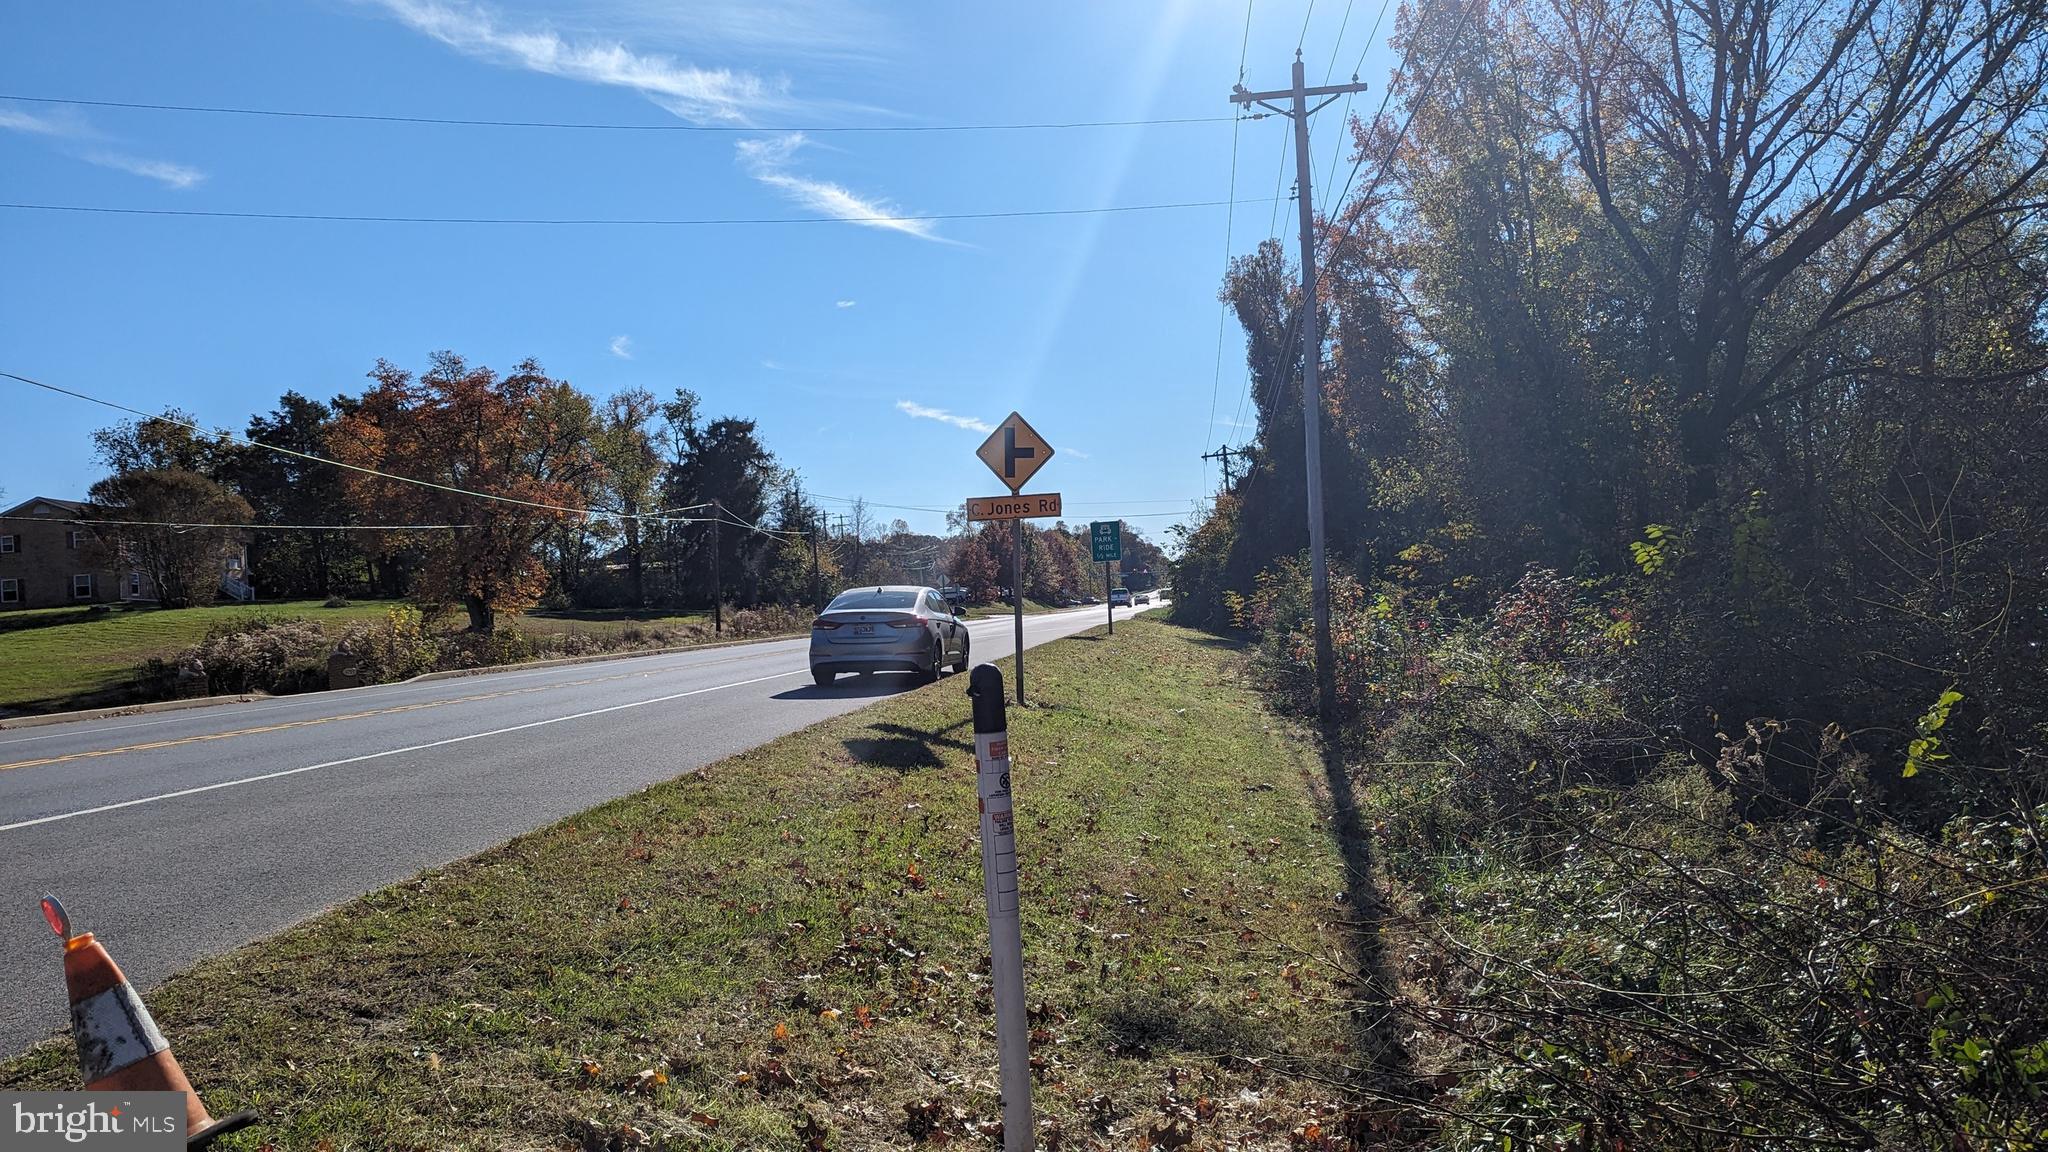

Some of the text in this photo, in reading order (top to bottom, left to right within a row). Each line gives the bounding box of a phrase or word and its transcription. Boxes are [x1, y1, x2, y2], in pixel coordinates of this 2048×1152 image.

[971, 499, 1058, 516] C. Jones Rd
